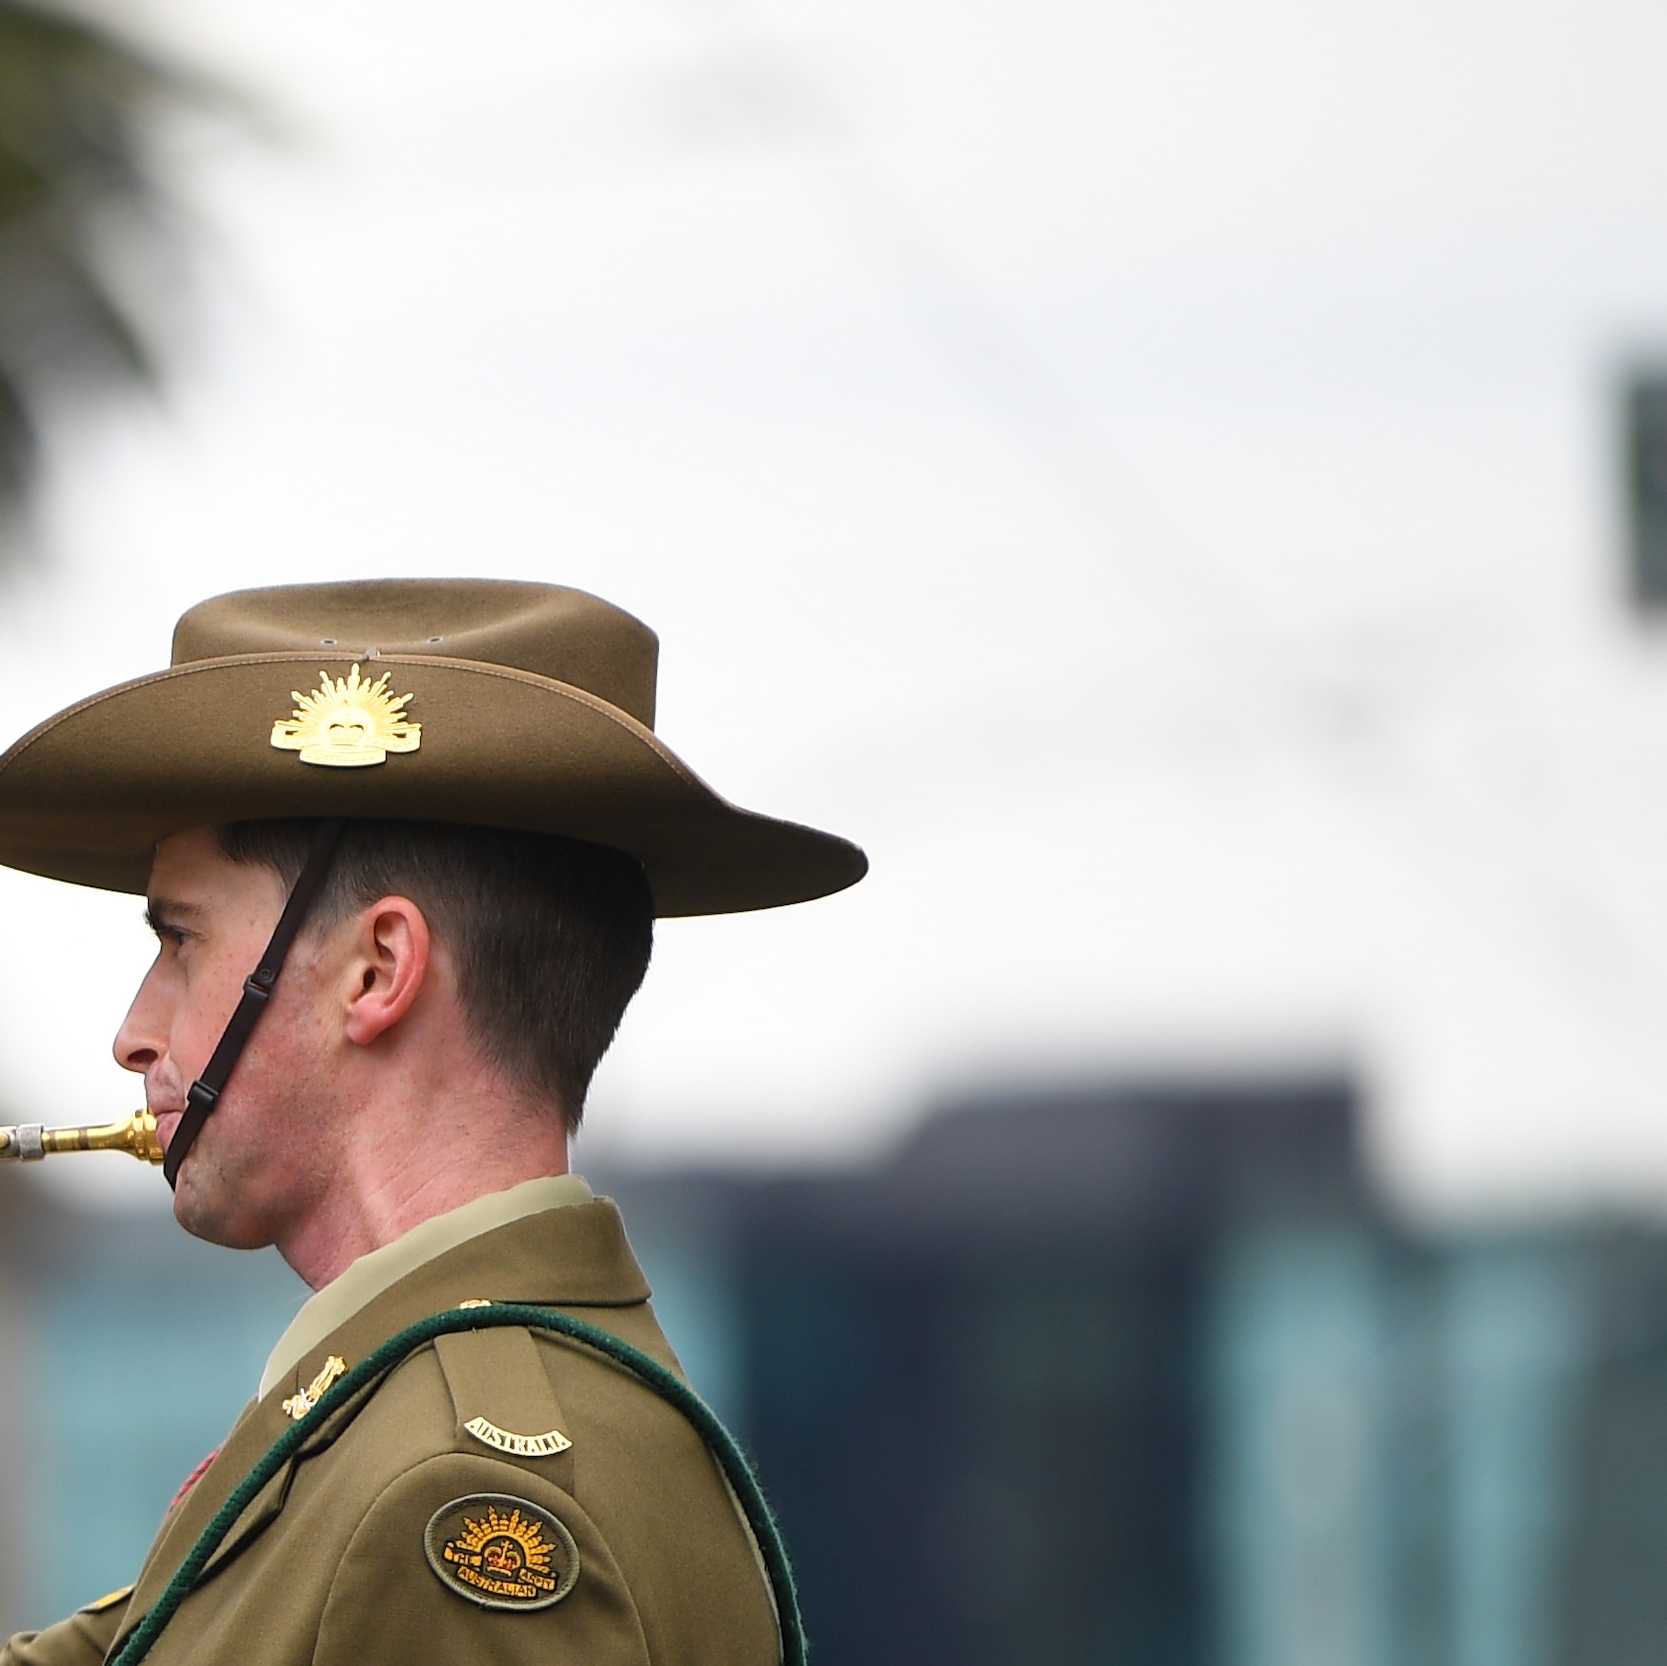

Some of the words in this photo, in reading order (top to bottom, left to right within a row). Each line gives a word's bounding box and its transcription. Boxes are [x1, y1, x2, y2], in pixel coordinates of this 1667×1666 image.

[464, 1416, 572, 1457] AUSTRALIA
[458, 1566, 538, 1597] AUSTRALIAN
[520, 1569, 556, 1591] ARMY
